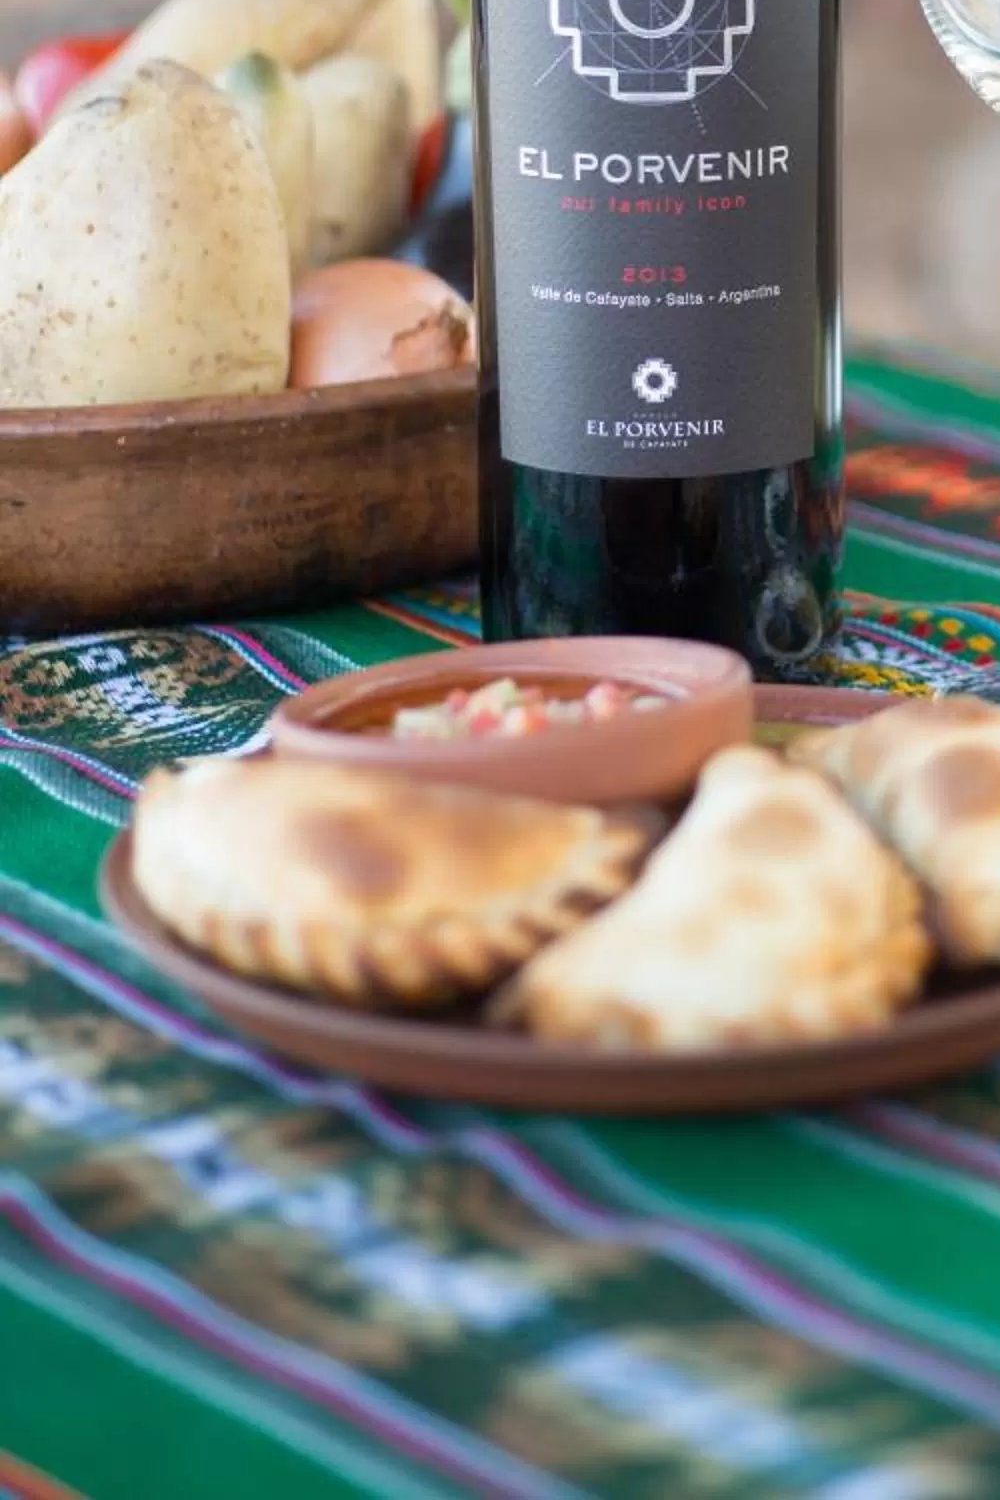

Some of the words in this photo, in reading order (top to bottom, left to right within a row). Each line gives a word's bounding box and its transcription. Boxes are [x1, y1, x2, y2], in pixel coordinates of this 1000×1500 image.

[518, 145, 563, 180] EL
[572, 145, 790, 184] PORVENIR
[559, 196, 594, 211] our
[609, 195, 686, 215] family
[697, 194, 746, 212] icon
[622, 264, 687, 284] 2013
[531, 284, 561, 300] Valle
[564, 289, 581, 303] de
[585, 290, 651, 309] Cafayate
[666, 291, 703, 306] Salta
[717, 283, 781, 305] Argentina
[586, 419, 609, 436] EL
[614, 419, 726, 437] PORVENIR
